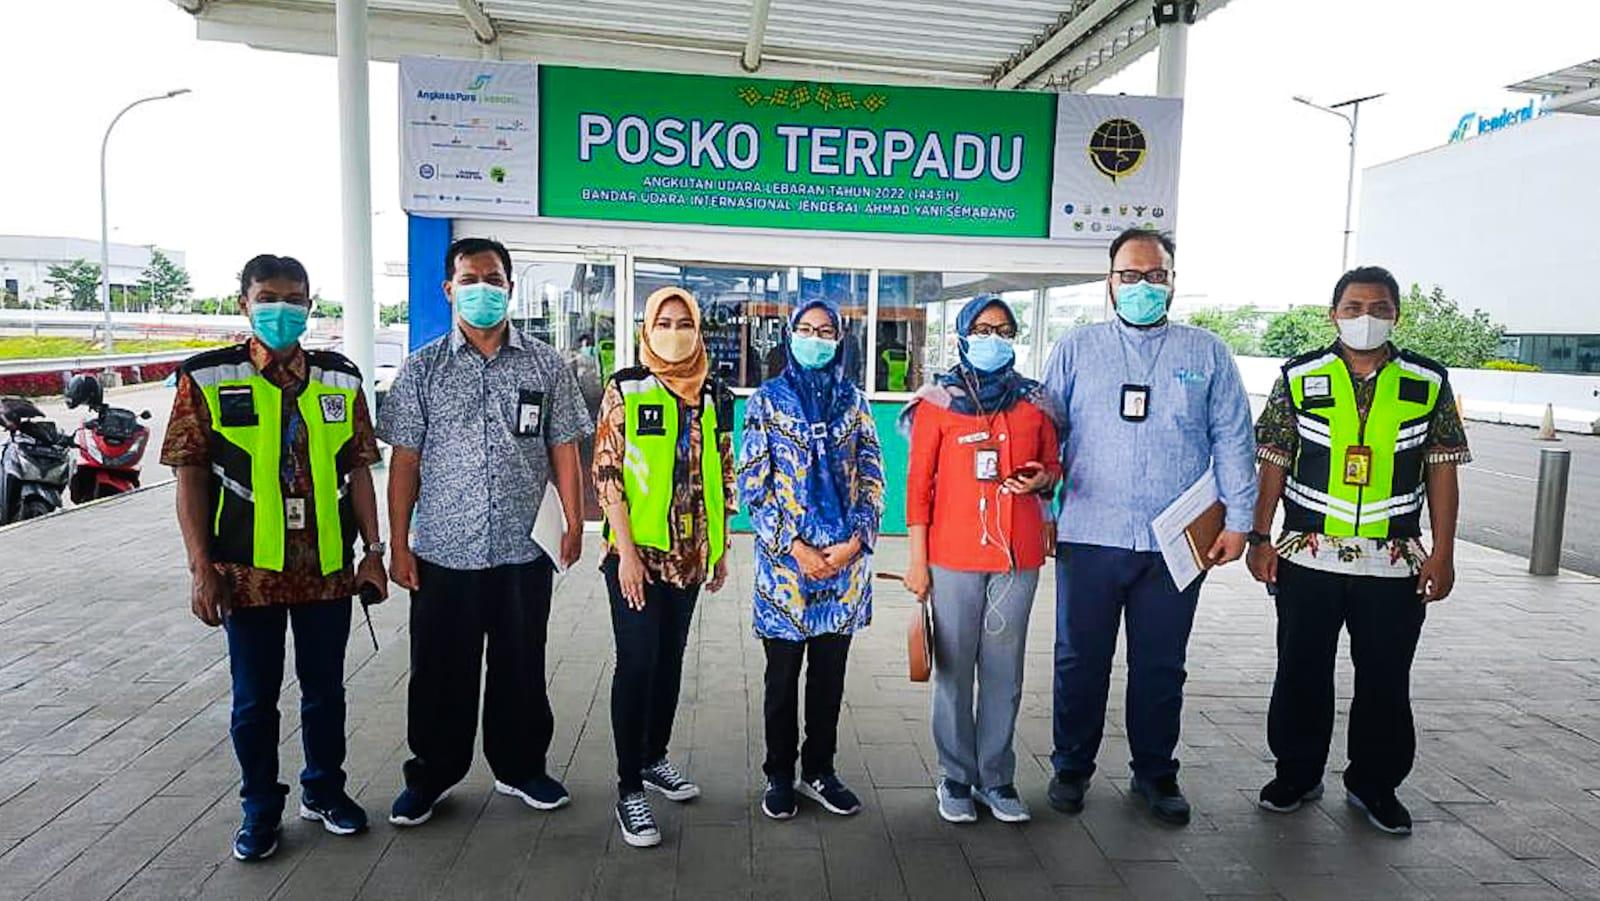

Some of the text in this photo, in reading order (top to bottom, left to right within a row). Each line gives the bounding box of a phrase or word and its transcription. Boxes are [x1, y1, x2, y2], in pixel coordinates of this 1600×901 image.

[578, 112, 1024, 182] POSKO TERPADU
[643, 176, 713, 190] ANGKUTAN
[717, 179, 761, 193] UDARA
[765, 182, 825, 196] LEBARAN
[829, 185, 871, 198] TAHUN
[875, 187, 905, 199] 2022
[582, 188, 1016, 219] BANDAR UDARA INTERNASIONAL JENDERAL AHMAD YANI SEMARANG
